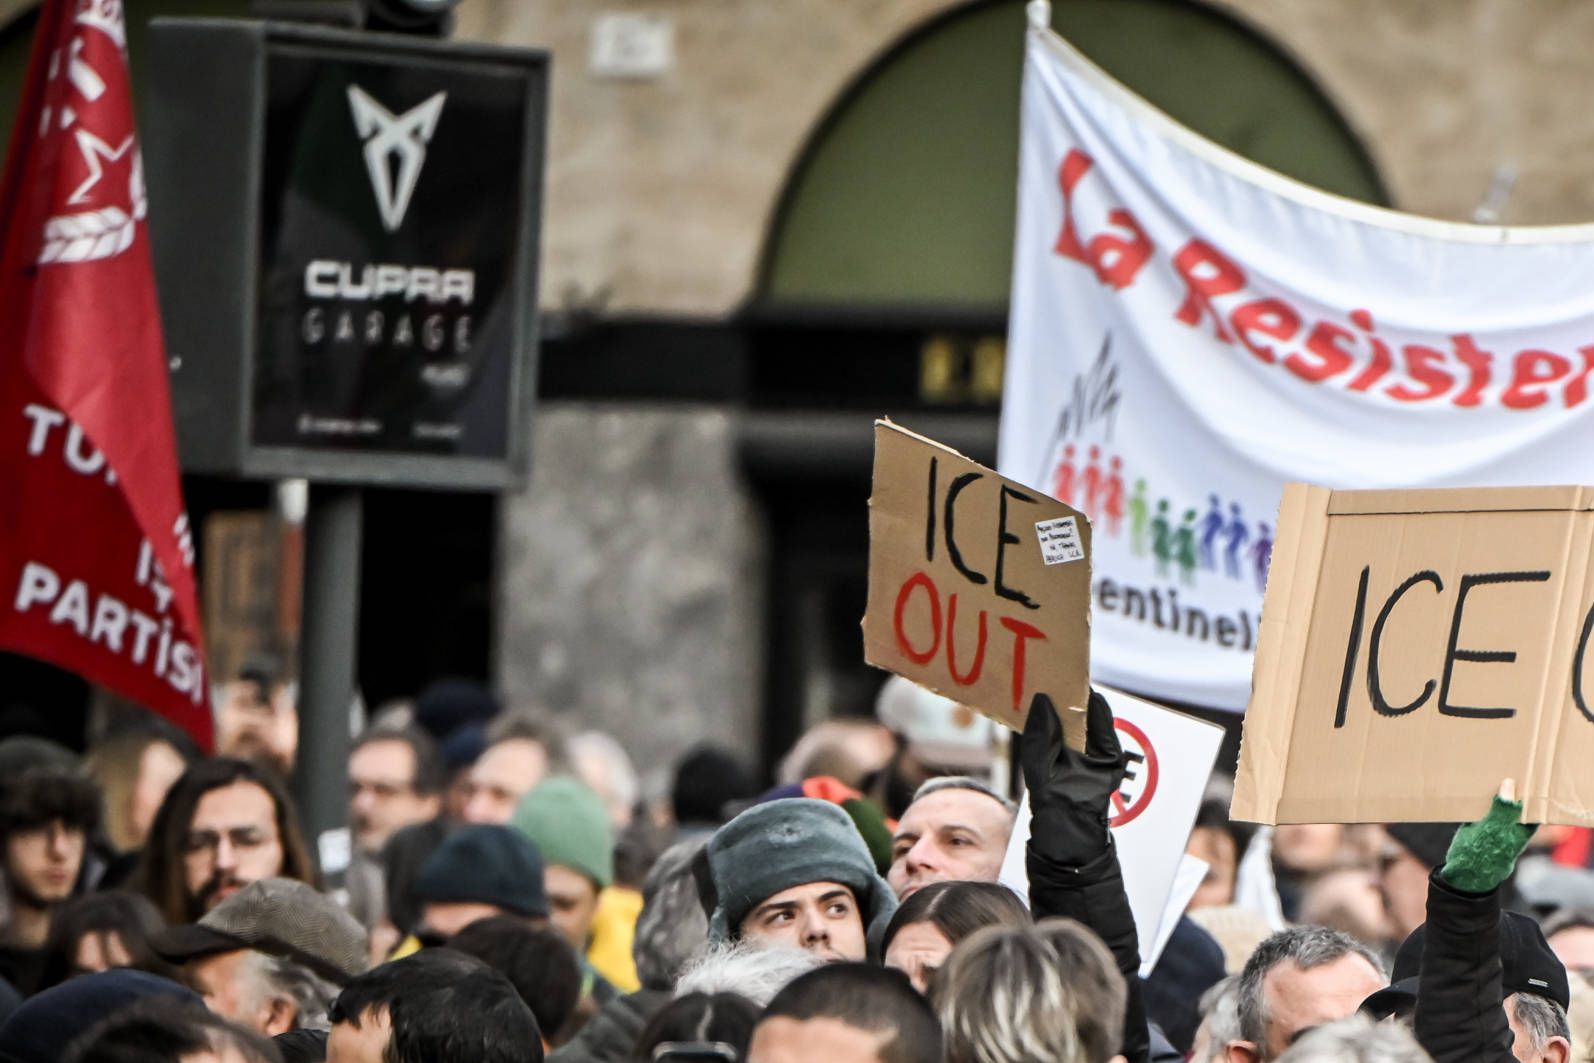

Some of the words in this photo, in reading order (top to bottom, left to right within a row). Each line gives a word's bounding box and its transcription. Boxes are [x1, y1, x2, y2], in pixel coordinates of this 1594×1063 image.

[304, 258, 475, 306] CUPRA
[1053, 146, 1156, 291] La
[302, 307, 471, 353] GARAGE
[926, 456, 1041, 610] ICE
[893, 571, 1048, 714] OUT
[1093, 575, 1263, 655] entinel
[1333, 563, 1551, 729] ICE
